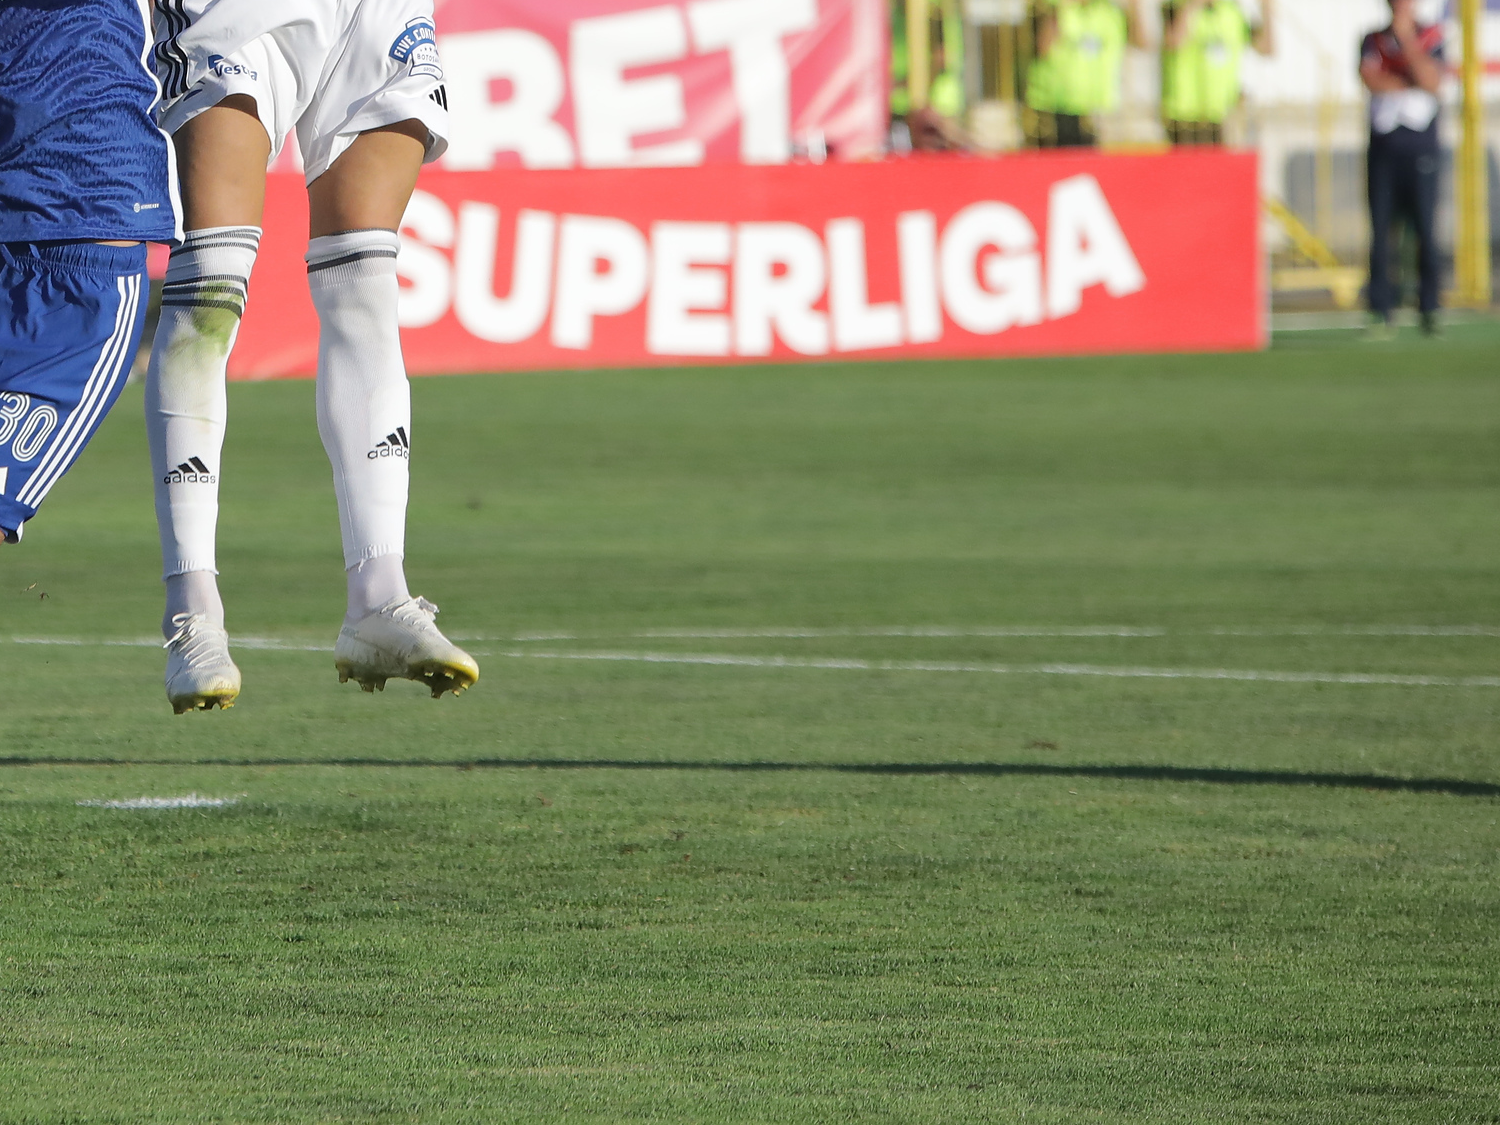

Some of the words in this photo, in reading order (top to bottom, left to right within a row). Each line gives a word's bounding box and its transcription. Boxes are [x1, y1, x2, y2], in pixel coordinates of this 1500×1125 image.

[393, 34, 415, 59] FIVE
[399, 173, 1146, 357] SUPERLIGA
[164, 472, 216, 484] adidas
